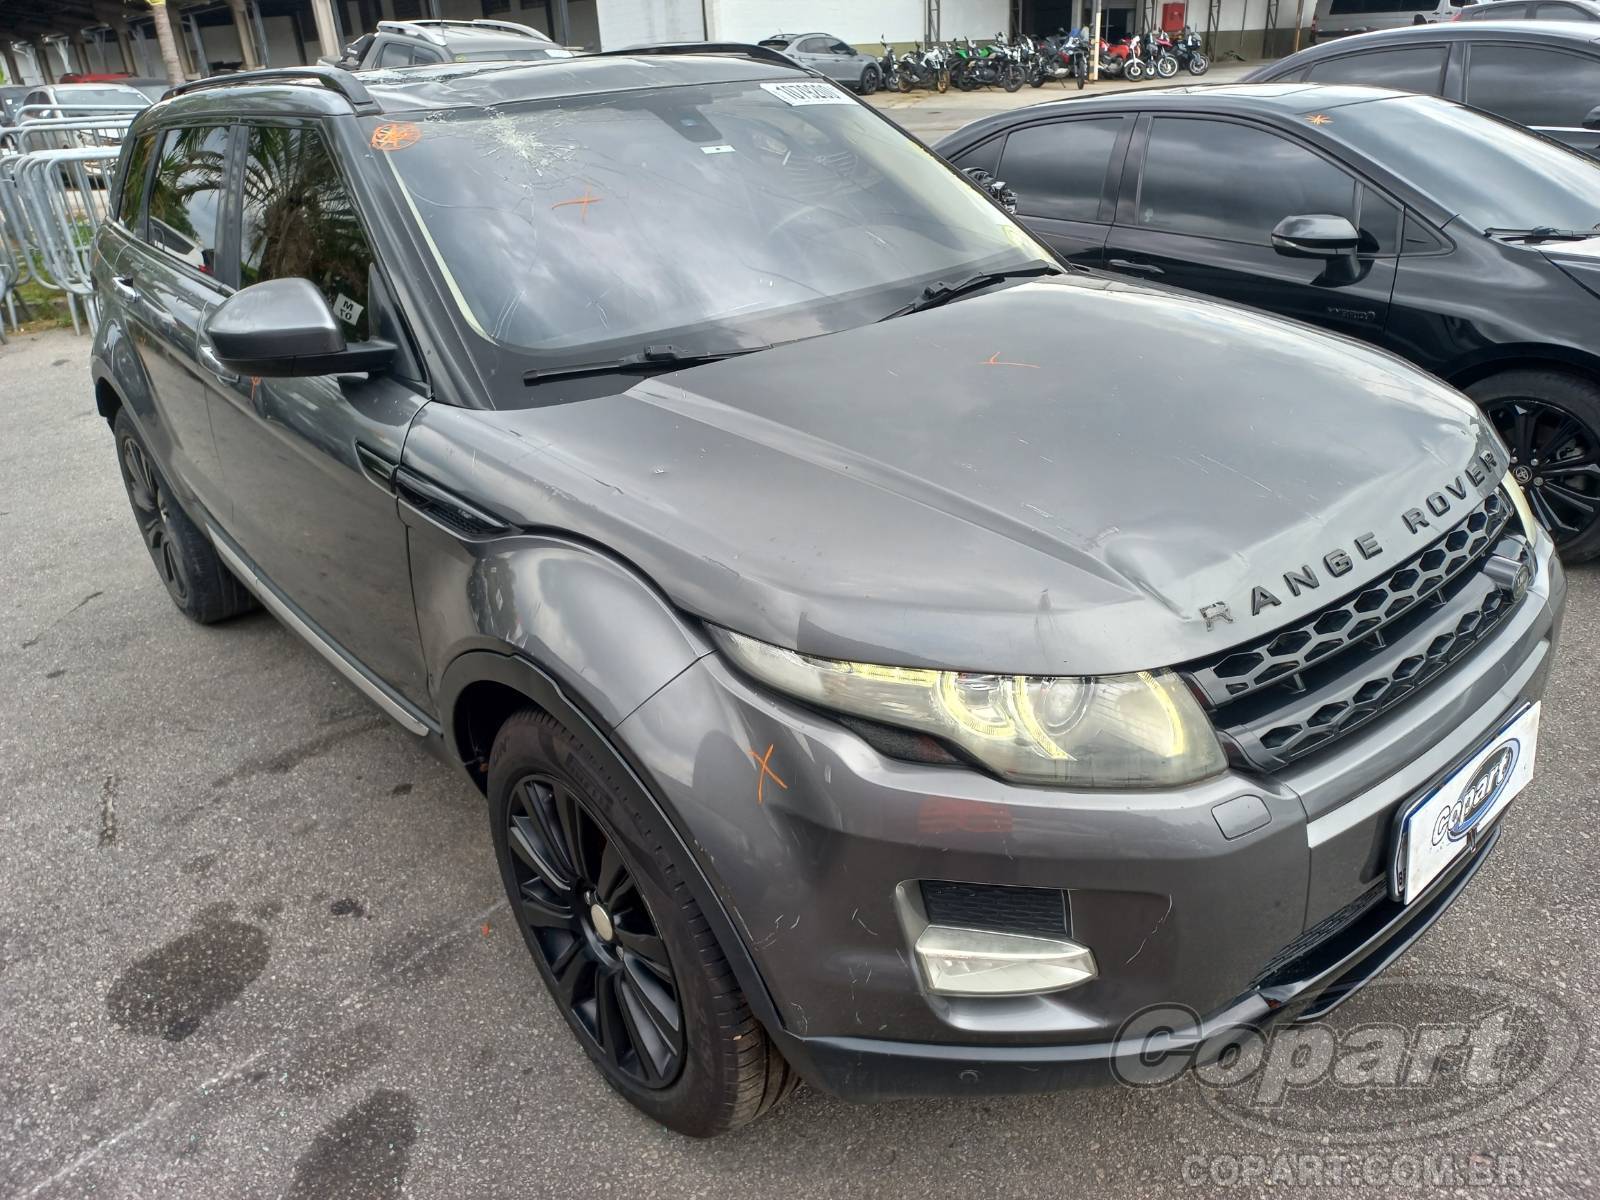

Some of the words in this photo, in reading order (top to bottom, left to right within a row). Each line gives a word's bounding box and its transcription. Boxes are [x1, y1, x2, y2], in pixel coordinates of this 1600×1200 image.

[343, 300, 354, 311] M
[1199, 531, 1383, 632] RANGE
[1401, 450, 1499, 534] ROVER
[1431, 747, 1511, 846] Copart
